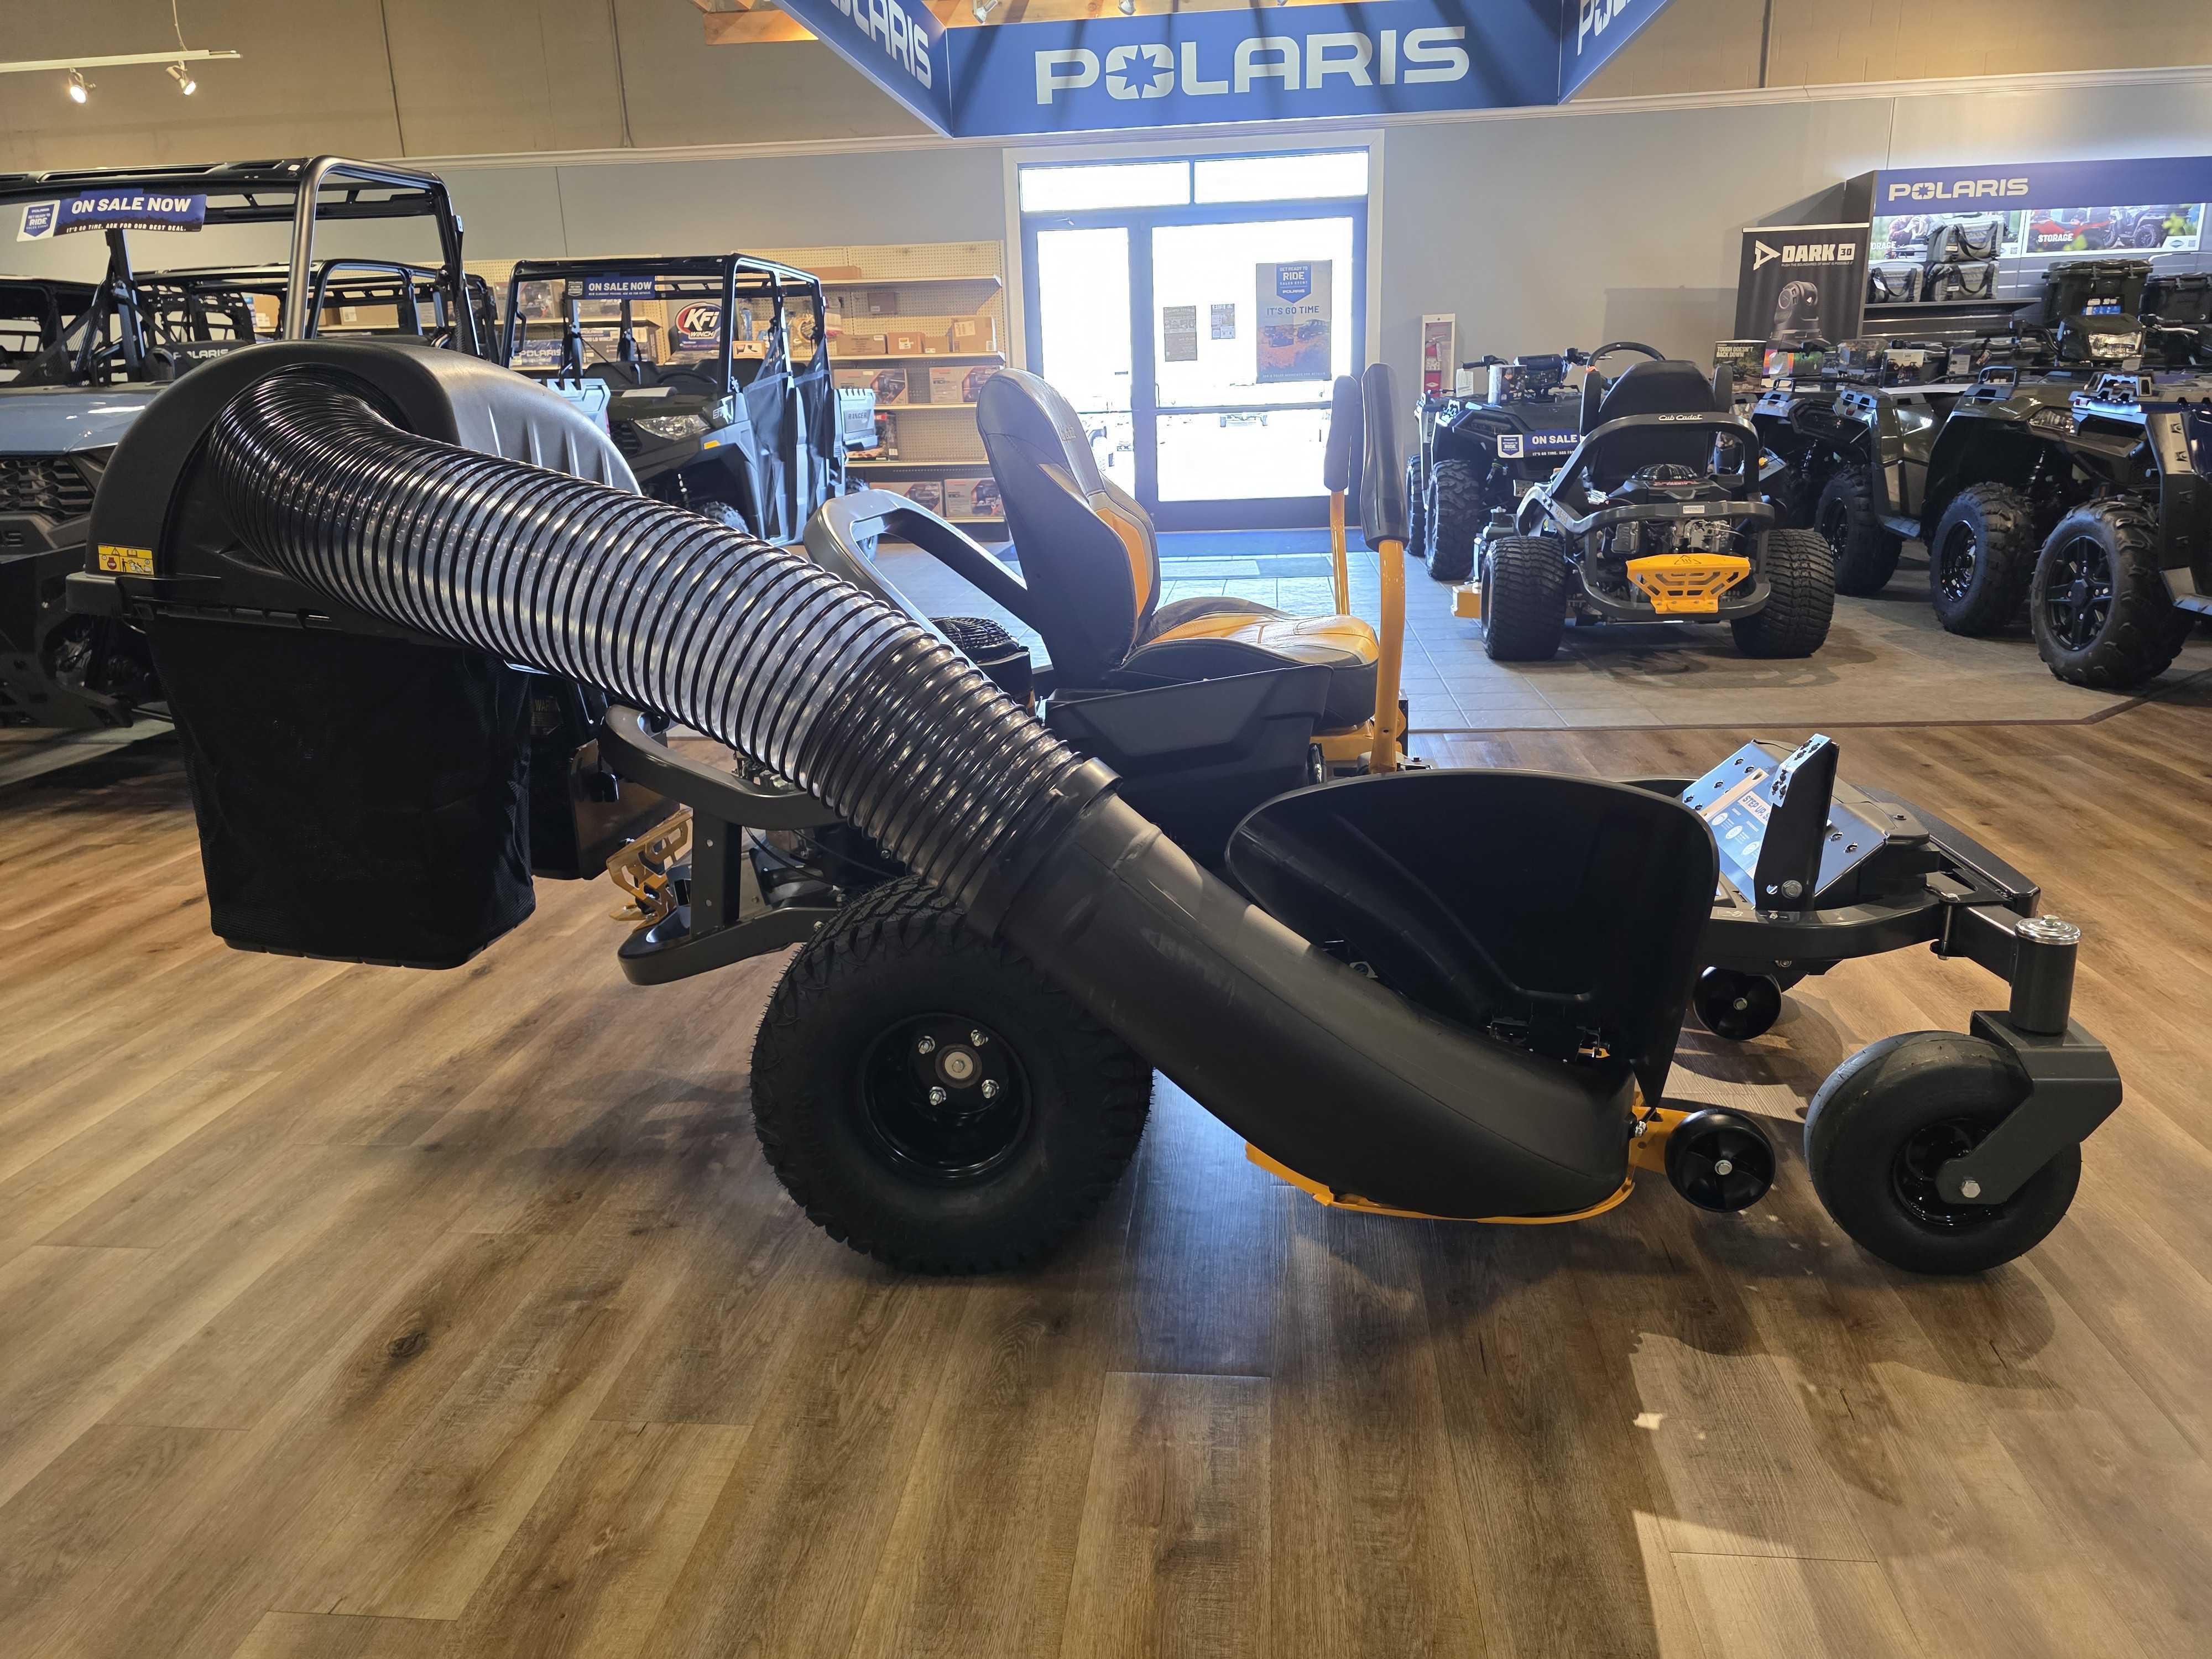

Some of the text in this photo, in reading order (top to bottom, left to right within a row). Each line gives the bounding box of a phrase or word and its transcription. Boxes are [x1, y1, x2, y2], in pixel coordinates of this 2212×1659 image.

[832, 0, 931, 90] LARIS
[1035, 26, 1470, 105] POLARIS
[1888, 178, 2028, 201] POLARIS
[71, 197, 191, 214] ON SALE NOW
[29, 217, 48, 226] RIDE
[2038, 233, 2073, 243] STORAGE
[1782, 244, 1836, 263] DARK
[1283, 272, 1305, 281] RIDE
[588, 283, 602, 291] ON
[603, 283, 628, 291] SALE
[630, 281, 652, 290] NOW
[1266, 307, 1283, 316] IT'S
[1300, 306, 1319, 314] TIME
[519, 348, 562, 360] POLARIS
[1532, 436, 1547, 445] ON
[1549, 434, 1578, 444] SALE
[1743, 795, 1758, 808] STEP
